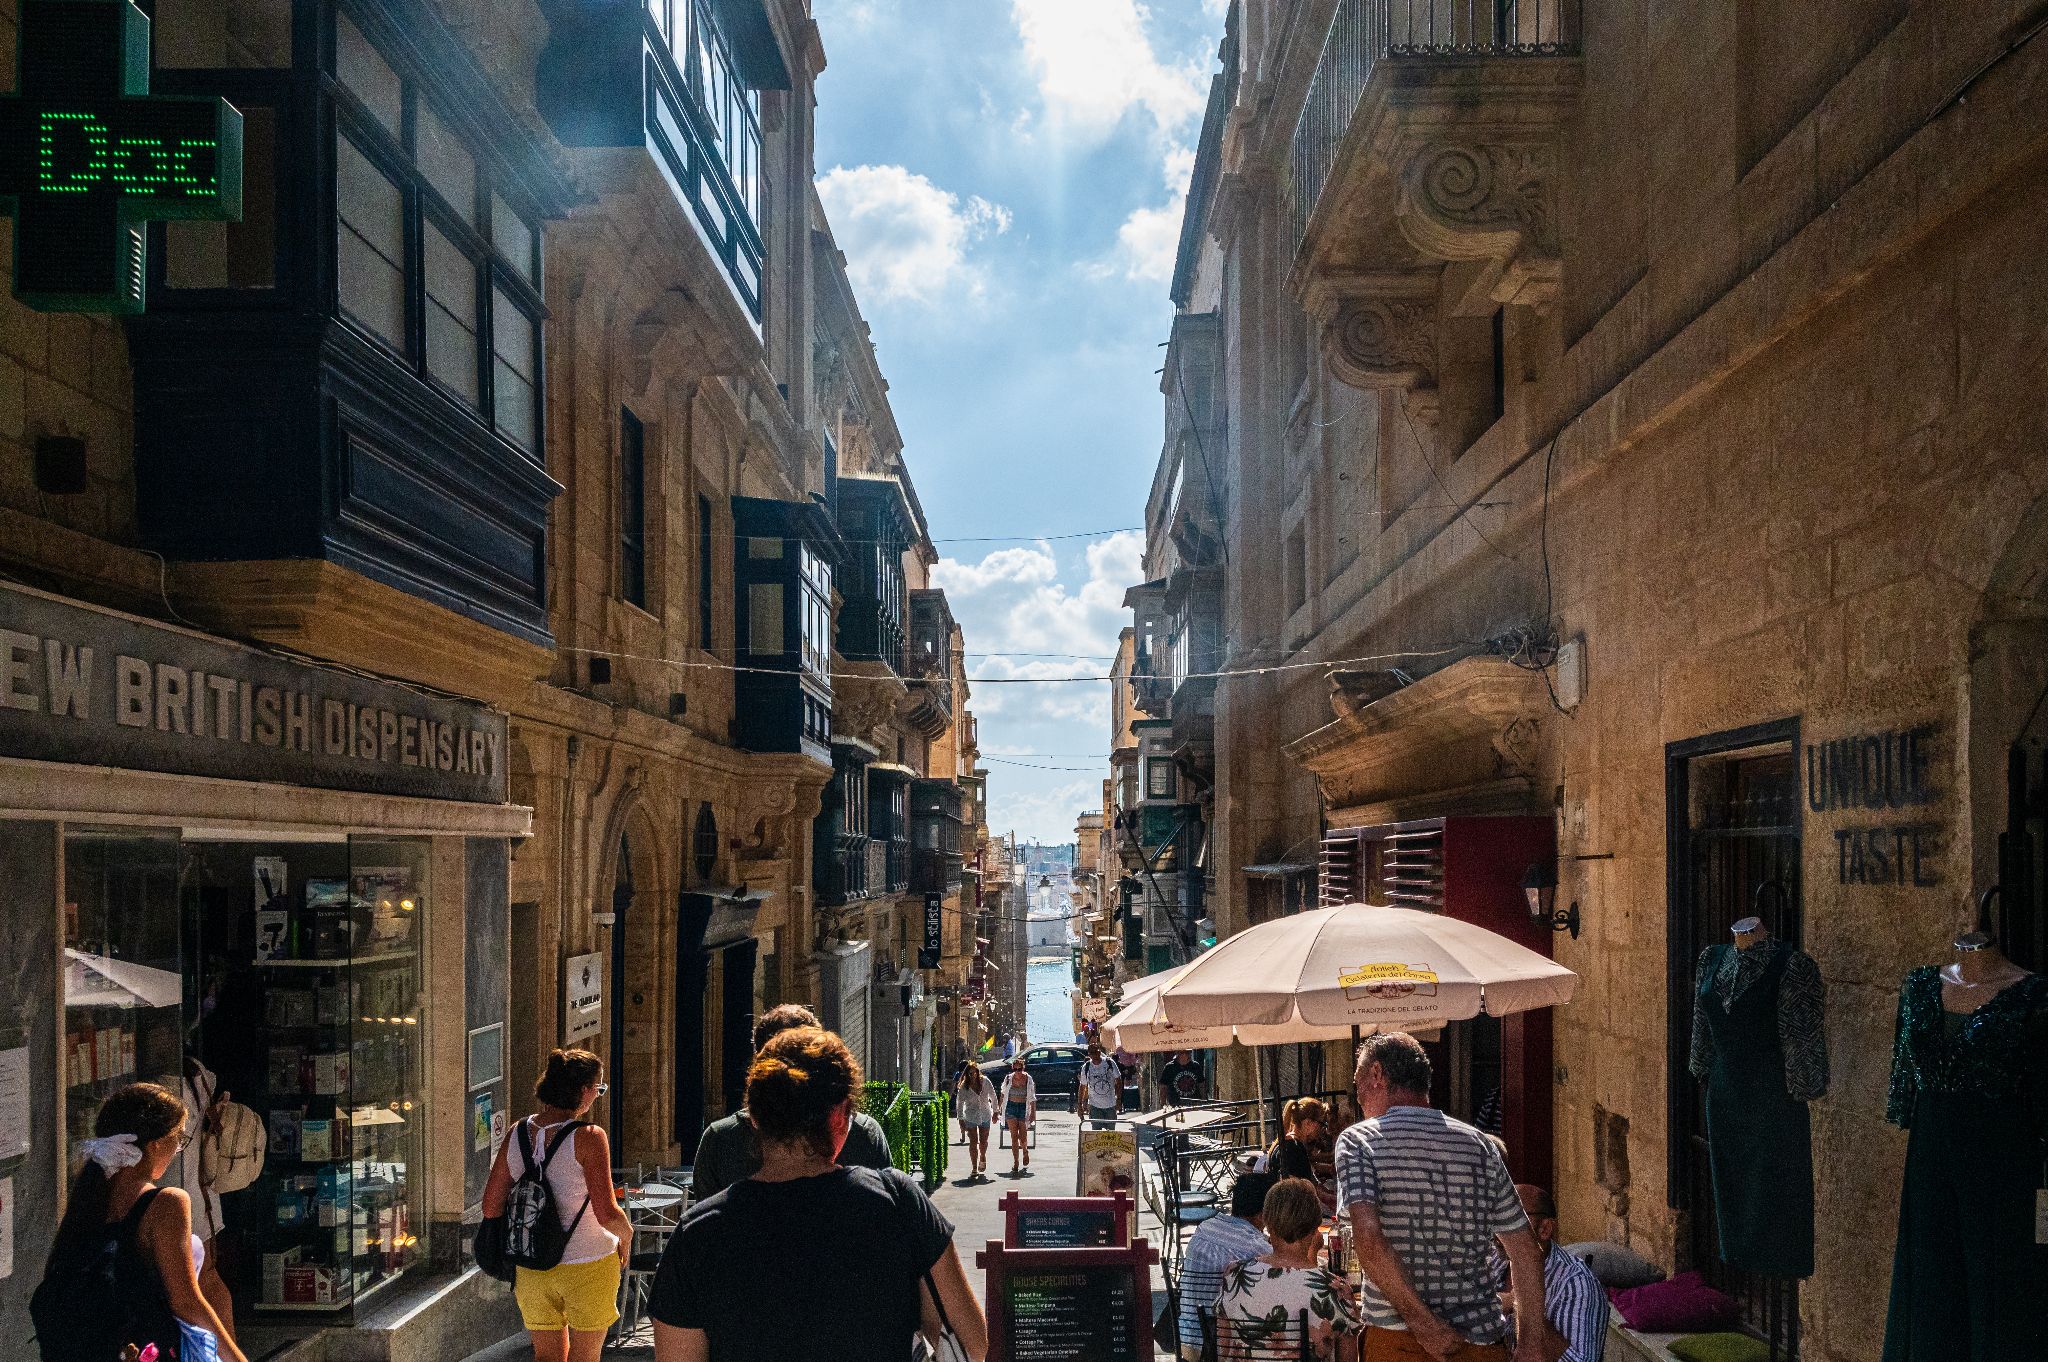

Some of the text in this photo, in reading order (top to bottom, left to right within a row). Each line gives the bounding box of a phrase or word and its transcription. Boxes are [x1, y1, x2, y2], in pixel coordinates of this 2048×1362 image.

[116, 655, 310, 751] BRITISH
[325, 699, 499, 777] DISPENSARY
[1807, 724, 1940, 813] UNIQUE
[1834, 825, 1938, 888] TASTE
[928, 900, 938, 948] lo stilista
